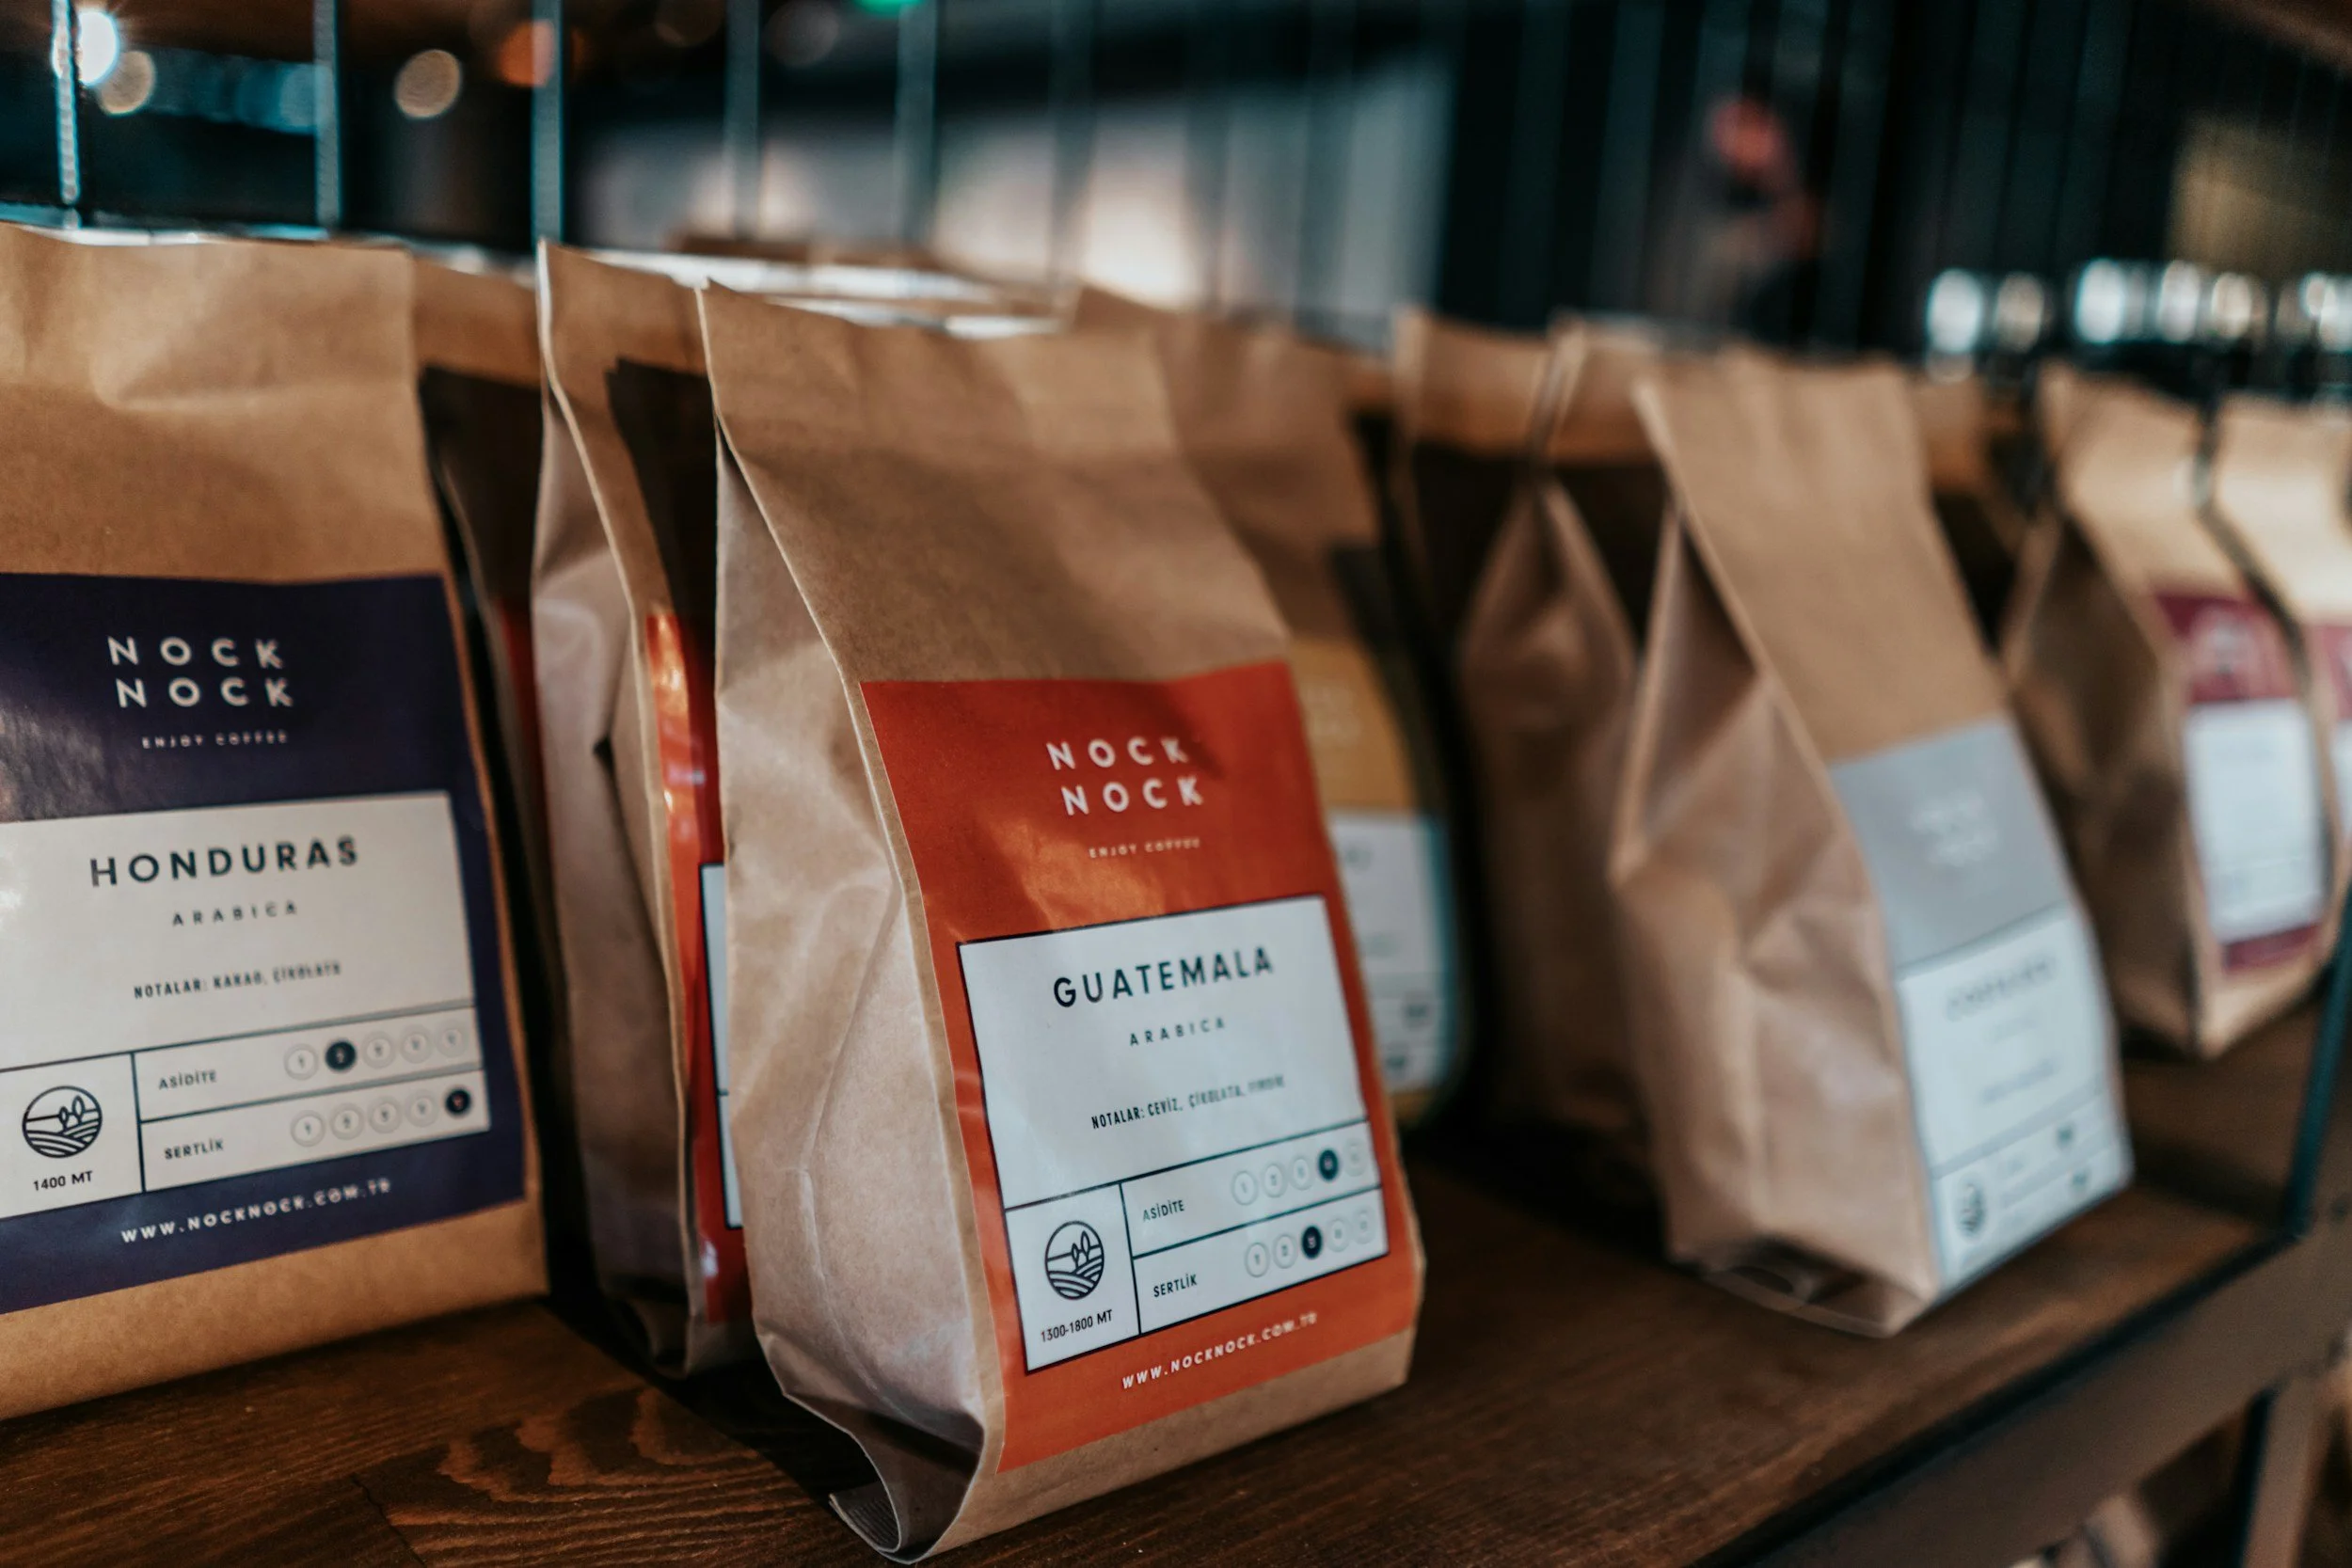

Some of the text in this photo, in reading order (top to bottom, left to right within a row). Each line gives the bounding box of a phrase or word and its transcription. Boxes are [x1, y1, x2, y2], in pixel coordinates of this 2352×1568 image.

[107, 636, 283, 669] NOCK
[115, 677, 293, 707] NOCK
[1046, 736, 1189, 770] NOCK
[1060, 776, 1204, 816] NOCK
[89, 835, 358, 887] HONDURAS
[172, 901, 298, 927] ARABICA
[1053, 945, 1274, 1008] GUATEMALA
[1129, 1016, 1226, 1047] ARABICA
[158, 1069, 218, 1091] ASİDİTE
[1091, 1106, 1145, 1130] NOTALAR:
[164, 1138, 225, 1161] SERTLİK
[33, 1170, 93, 1193] 1400 MT
[121, 1177, 391, 1243] WWW.NOCKNOCK.COM.TR
[1142, 1198, 1185, 1222] ASİDİTE
[1152, 1273, 1198, 1298] SERTLİK
[1041, 1308, 1114, 1343] 1300-1800 MT
[1121, 1311, 1317, 1390] WWW.NOCKNOCK.COM.TR
